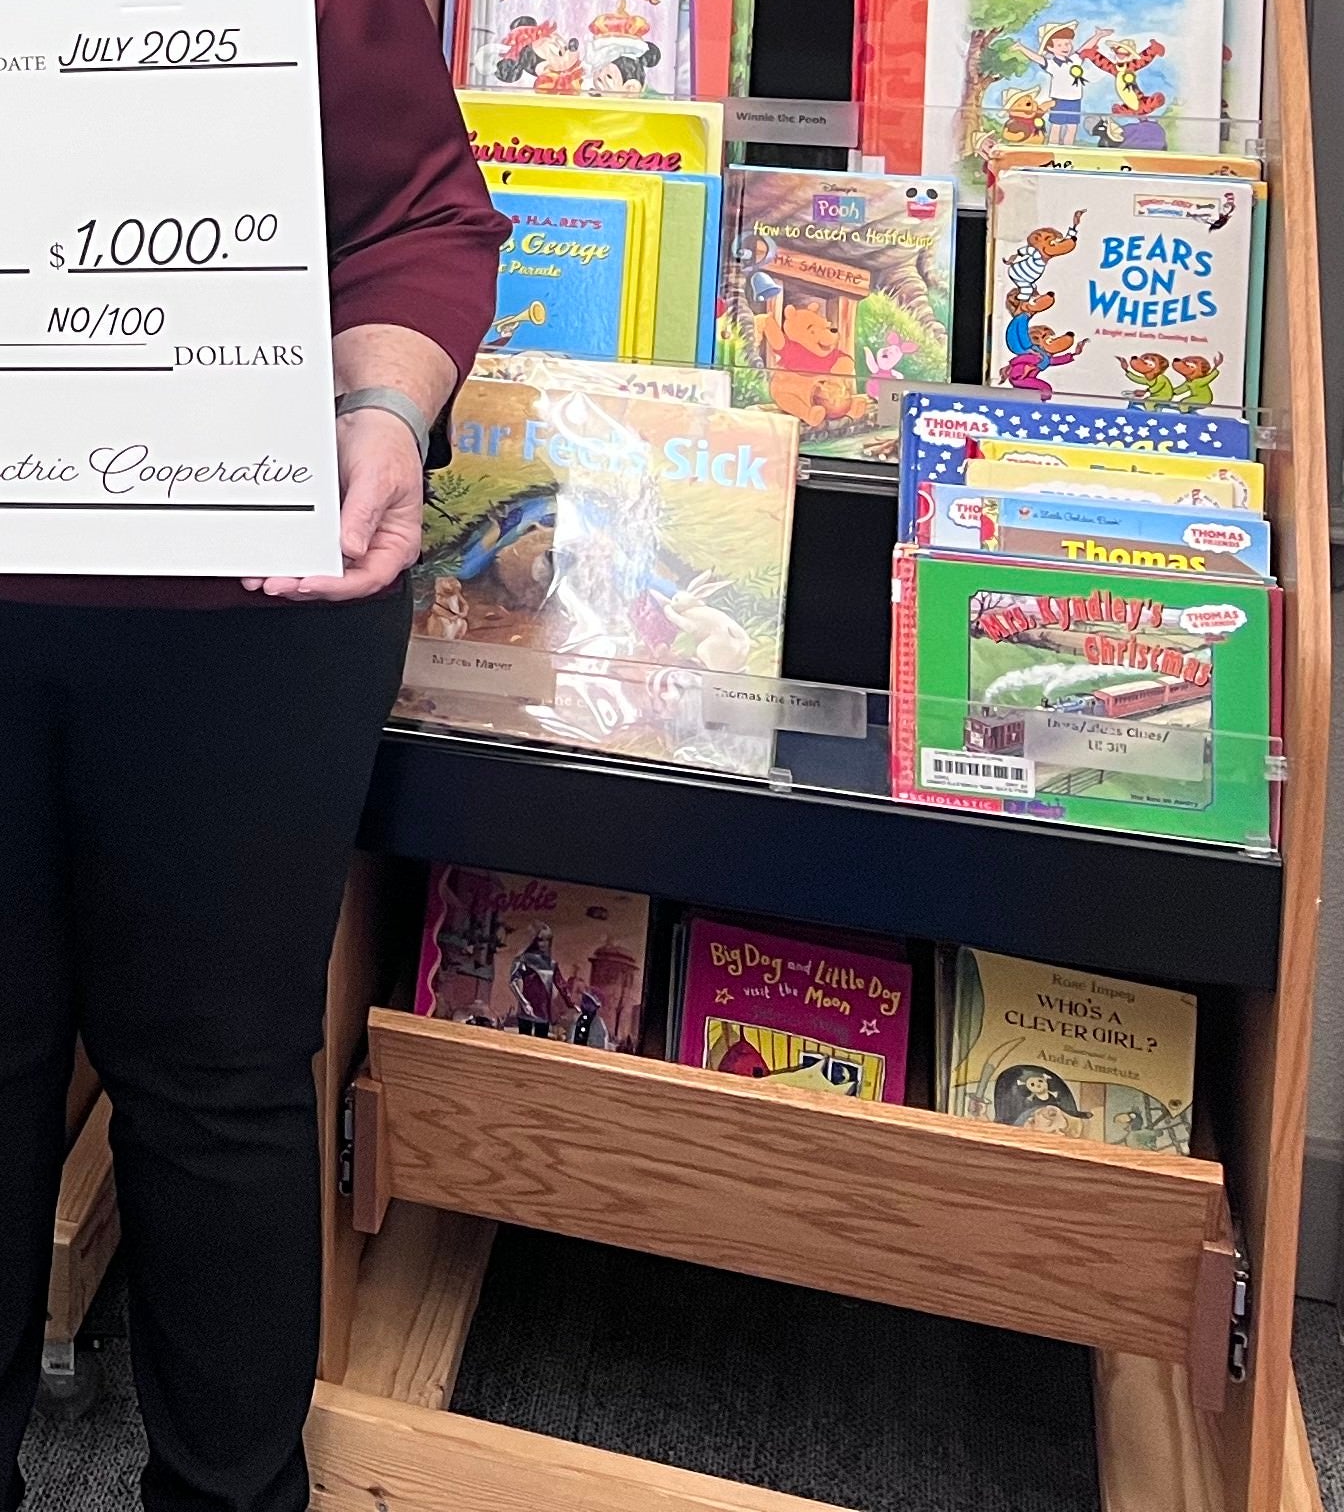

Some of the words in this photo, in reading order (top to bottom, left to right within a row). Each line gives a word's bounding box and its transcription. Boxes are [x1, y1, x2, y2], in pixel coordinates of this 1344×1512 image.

[58, 33, 134, 67] JULY
[138, 28, 240, 65] 2025
[736, 112, 774, 123] Winnie
[777, 113, 795, 124] the
[798, 114, 826, 125] Pooh
[817, 200, 859, 219] Pooh
[753, 221, 782, 237] How
[784, 224, 800, 238] to
[805, 225, 847, 242] Catch
[851, 232, 860, 242] a
[521, 232, 611, 264] George
[1099, 233, 1213, 277] BEARS
[1122, 266, 1176, 295] ON
[1089, 279, 1218, 327] WHEELS
[47, 307, 165, 339] NO/100
[174, 345, 304, 367] DOLLARS
[923, 416, 989, 434] THOMAS
[89, 444, 313, 497] Cooperative
[664, 437, 768, 489] Sick
[1190, 528, 1244, 542] THOMAS
[1061, 540, 1208, 572] Thomas
[980, 606, 1037, 644] Mrs.
[1037, 589, 1164, 631] Kyndley's
[1186, 610, 1238, 622] THOMAS
[1083, 634, 1213, 686] Christmas
[710, 941, 742, 975] Big
[744, 943, 783, 984] Dog
[787, 958, 813, 976] and
[814, 959, 864, 990] Little
[867, 975, 901, 1016] Dog
[777, 983, 798, 998] the
[804, 987, 851, 1016] Moon
[1037, 994, 1102, 1020] WHO'S
[1108, 1011, 1122, 1024] A
[1005, 1010, 1088, 1041] CLEVER
[1036, 1050, 1078, 1068] André
